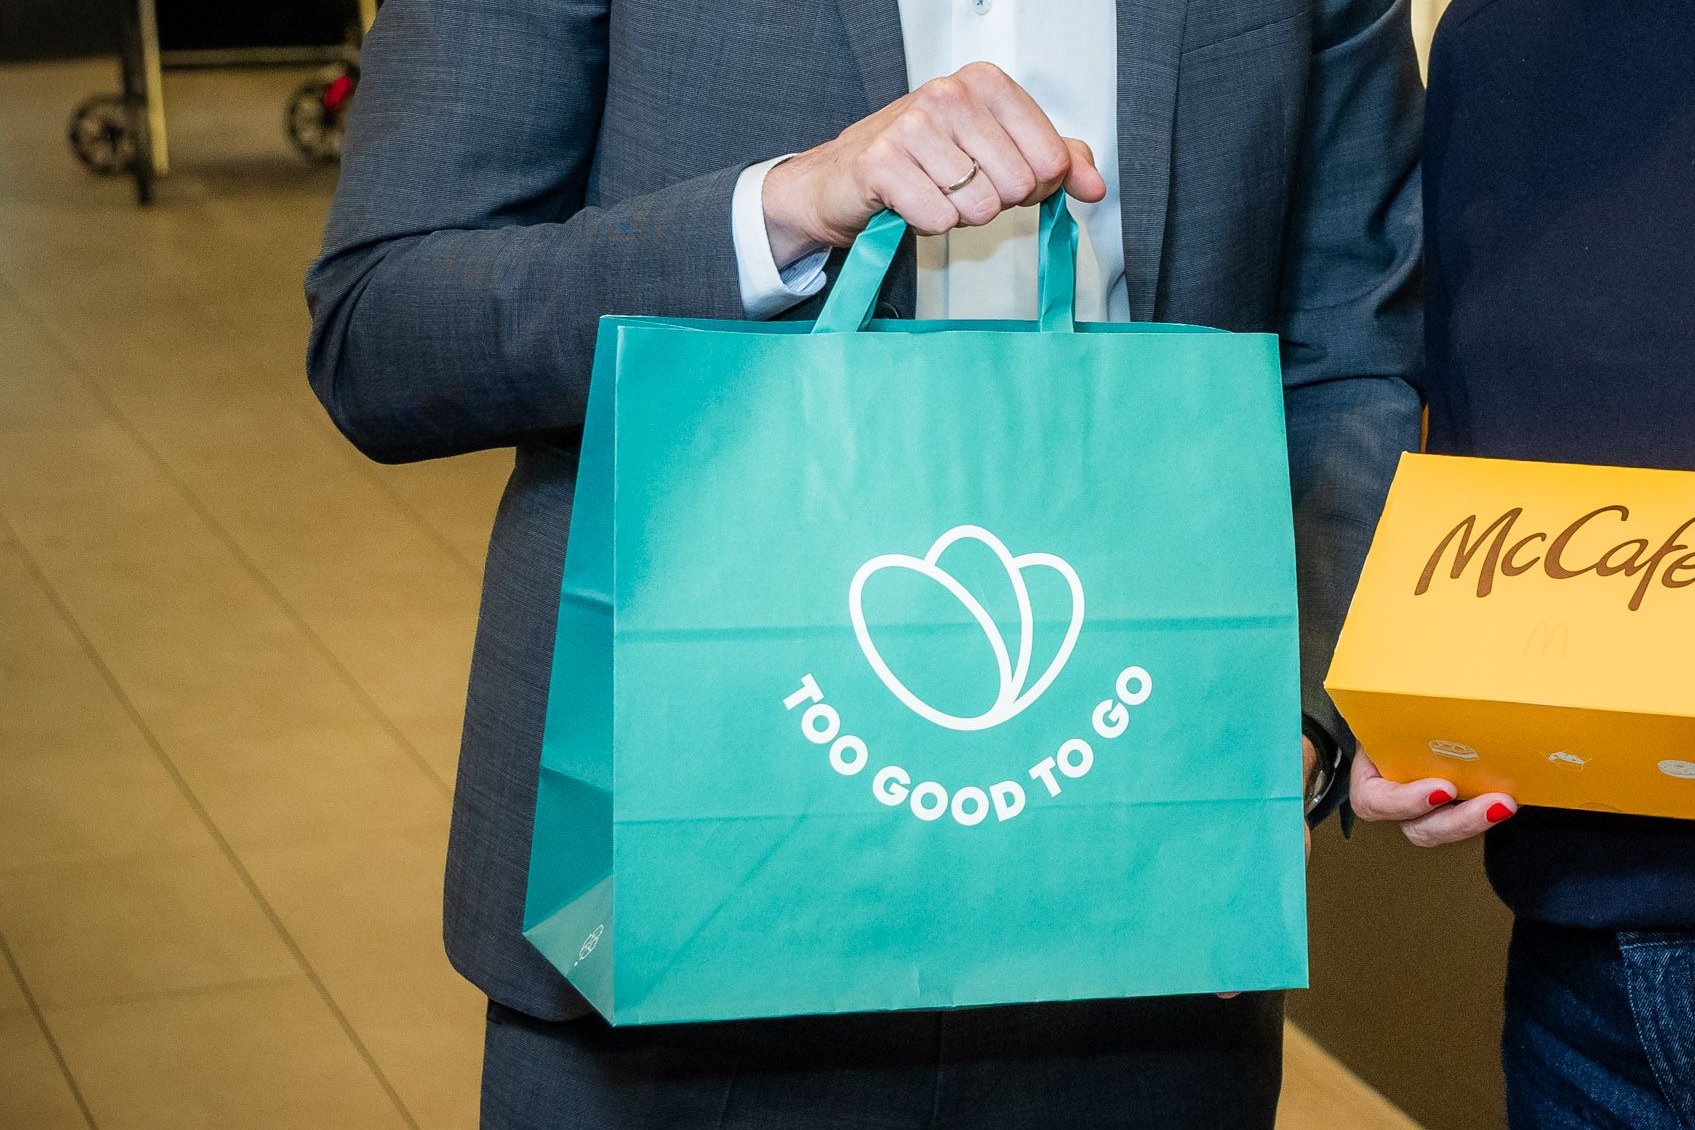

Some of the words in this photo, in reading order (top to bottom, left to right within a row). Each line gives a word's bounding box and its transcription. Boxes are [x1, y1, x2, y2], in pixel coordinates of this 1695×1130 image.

[782, 673, 869, 776] TOO
[872, 765, 1026, 826] GOOD
[1028, 738, 1094, 798] TO
[1091, 665, 1153, 739] GO
